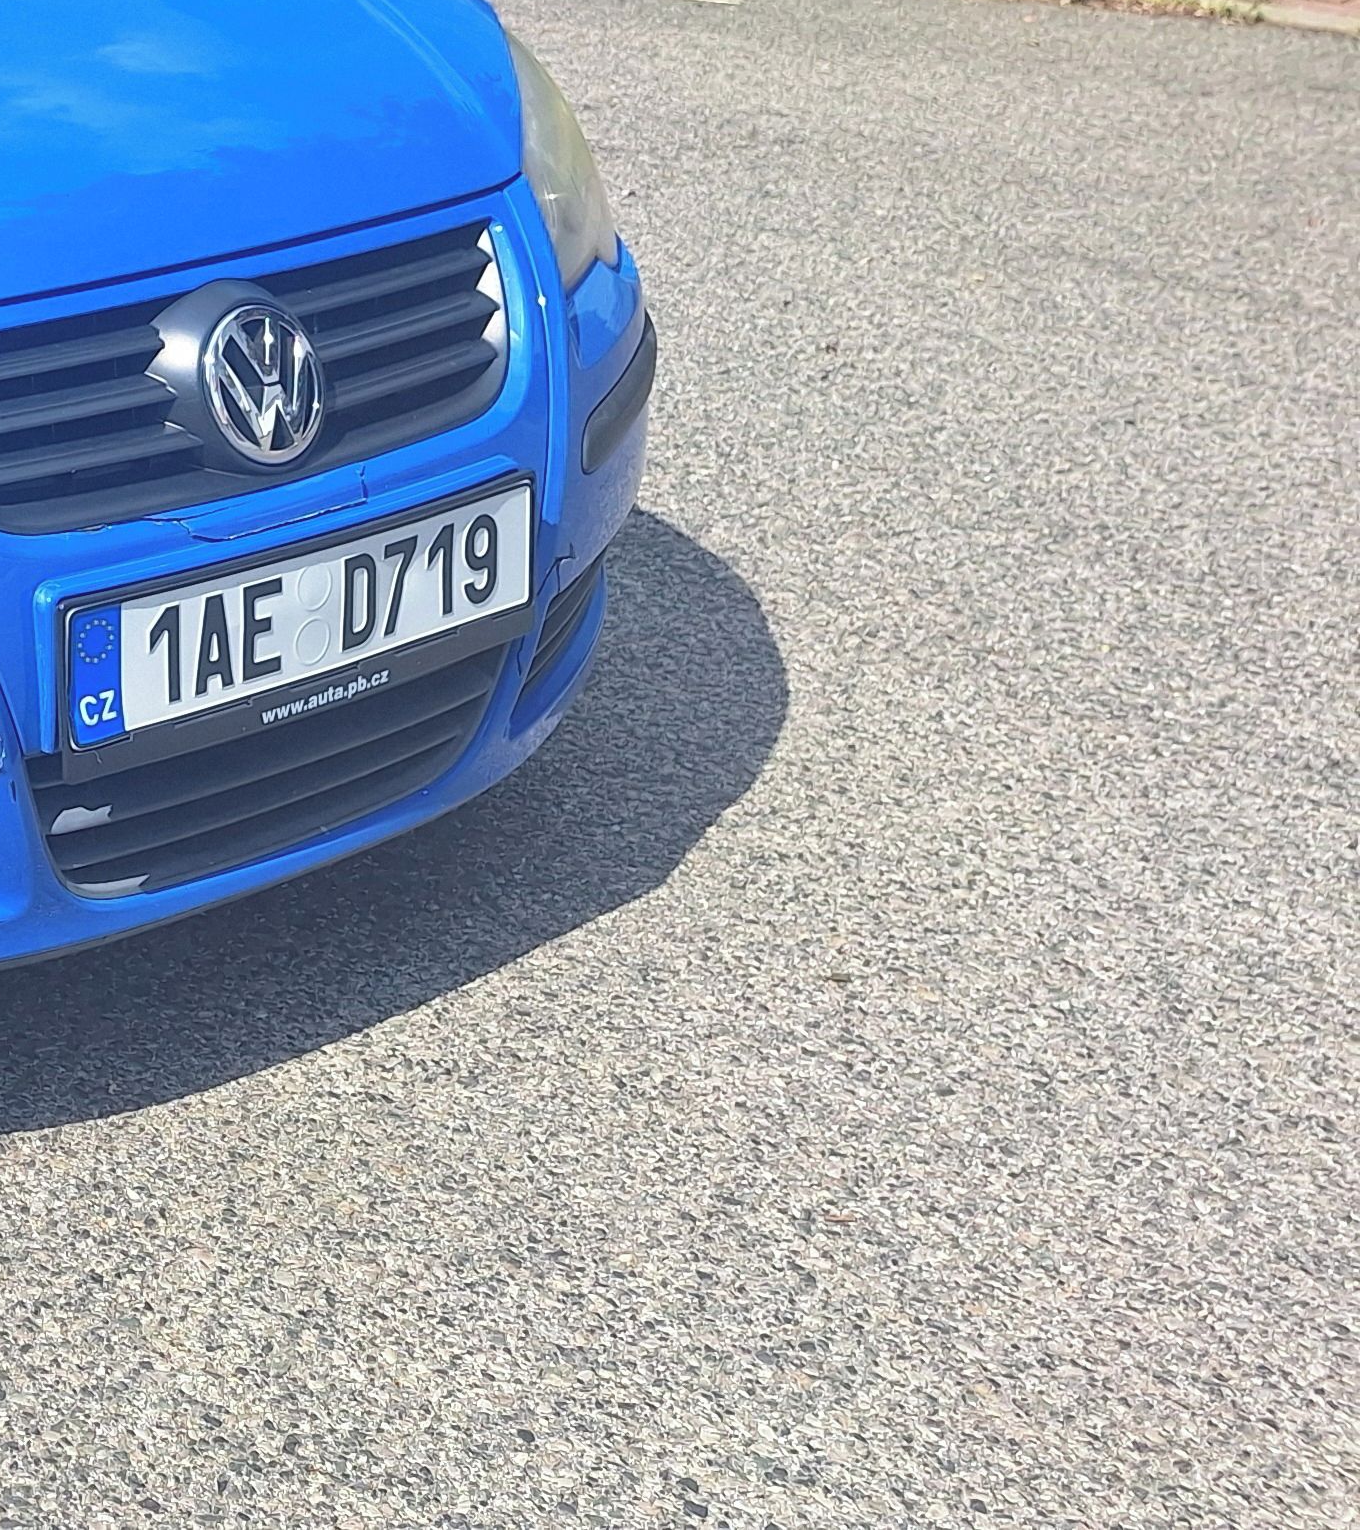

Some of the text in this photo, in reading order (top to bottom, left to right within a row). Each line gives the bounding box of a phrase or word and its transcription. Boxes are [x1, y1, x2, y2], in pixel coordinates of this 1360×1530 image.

[204, 303, 324, 465] VW
[145, 513, 499, 706] 1AE D719
[79, 688, 118, 727] CZ
[260, 668, 391, 726] www.auta.pb.cz
